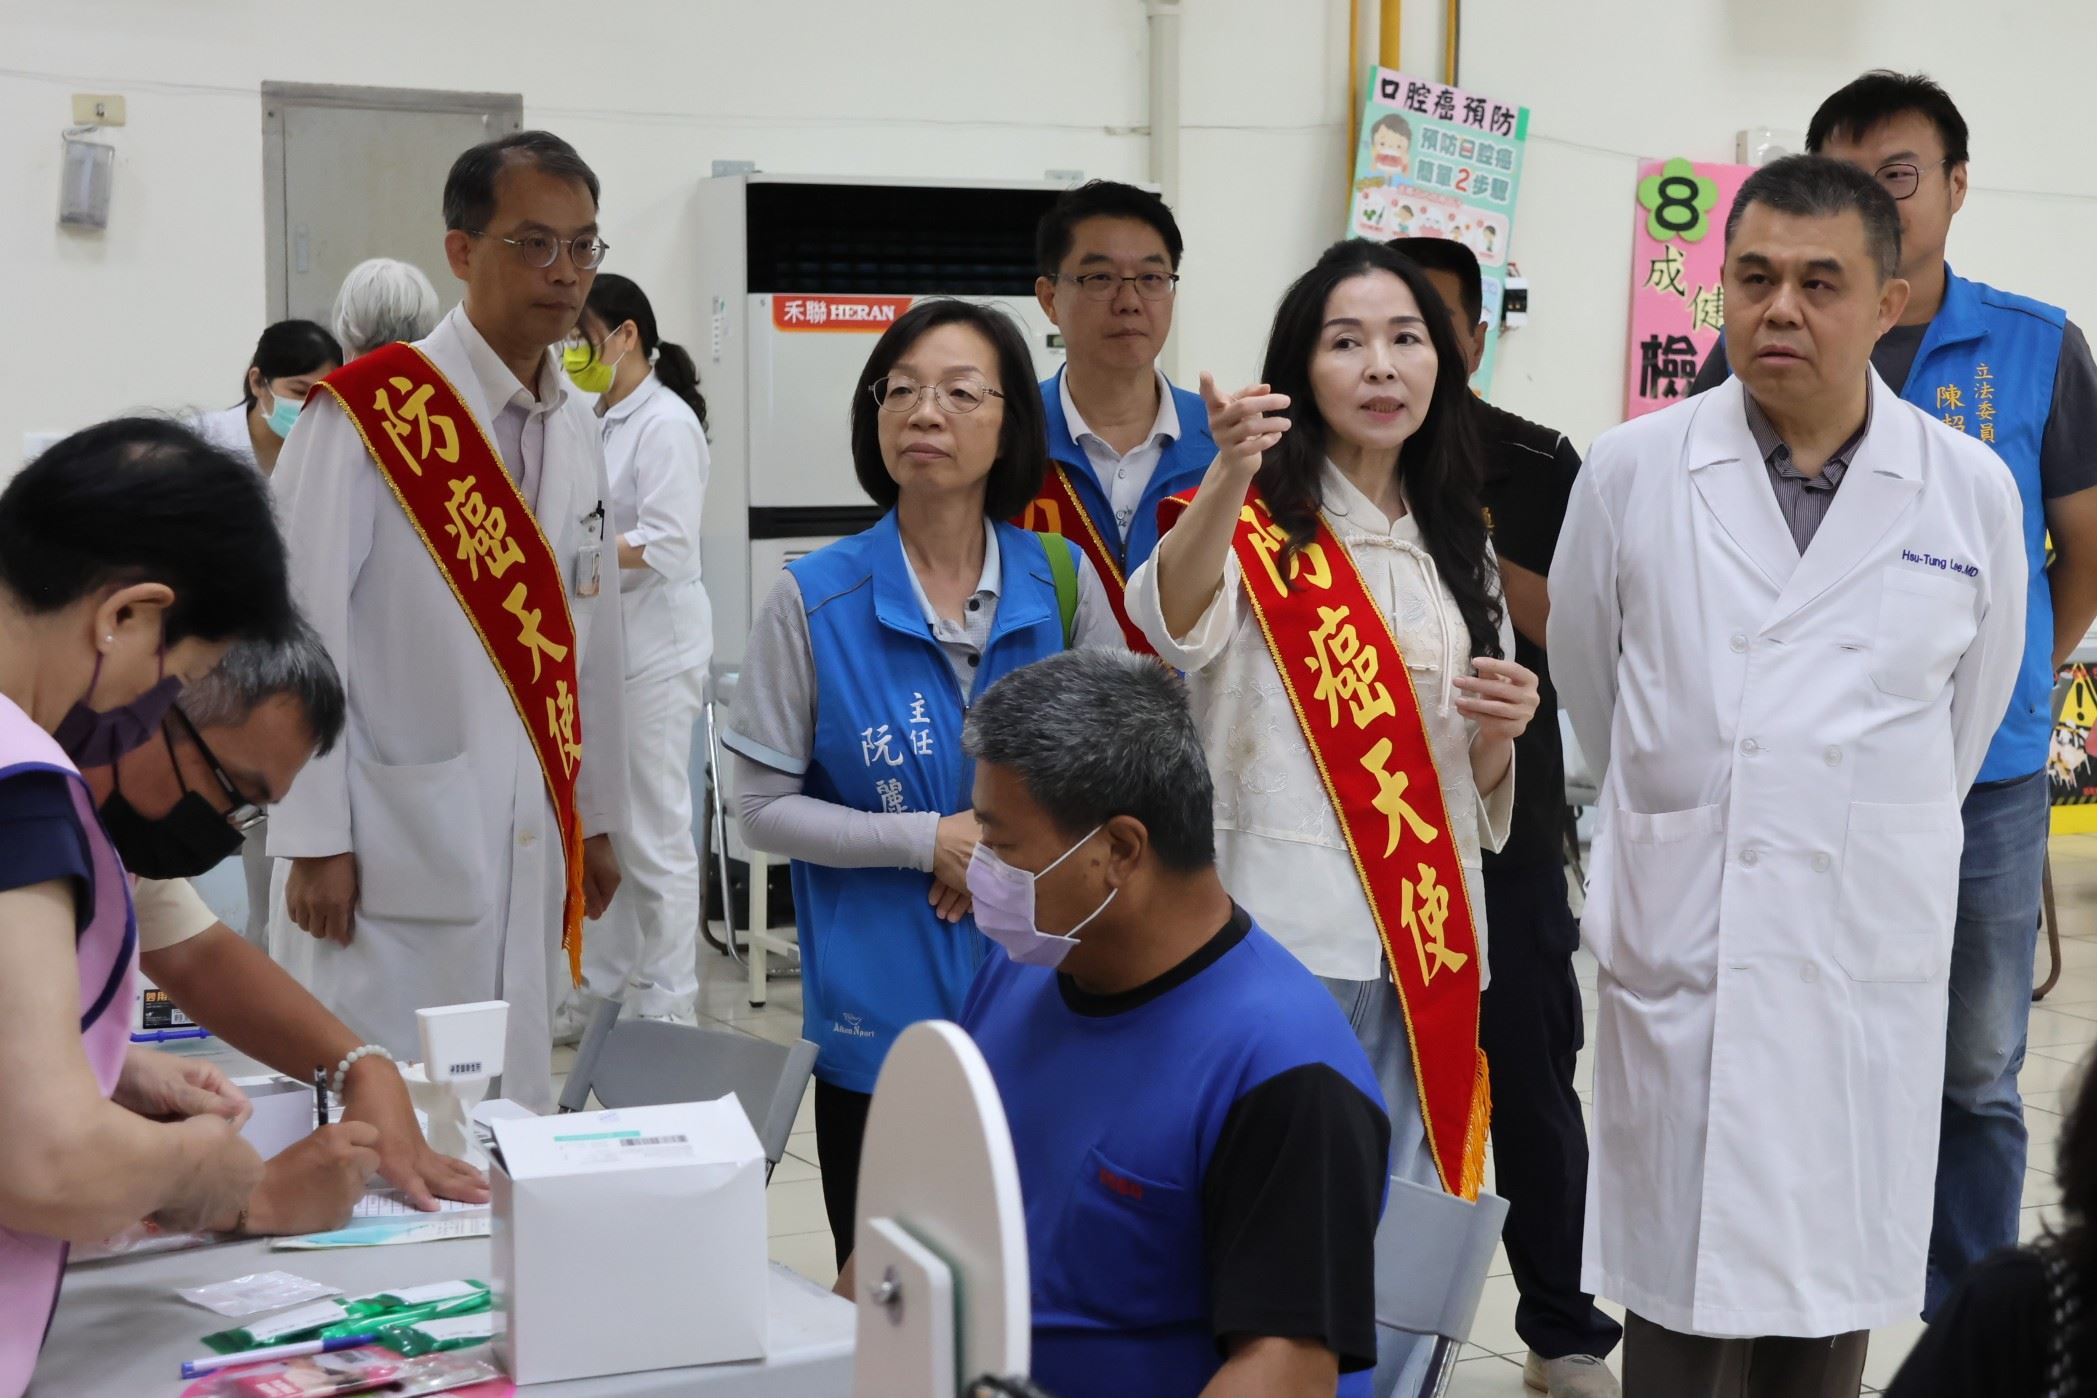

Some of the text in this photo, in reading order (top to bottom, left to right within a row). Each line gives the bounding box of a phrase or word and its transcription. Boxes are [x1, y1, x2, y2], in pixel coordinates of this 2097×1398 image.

[1381, 78, 1515, 137] 口腔癌預防
[1420, 126, 1514, 171] 預防口腔癌
[1655, 176, 1699, 231] 8
[784, 300, 896, 324] 禾聯 HERAN
[1973, 362, 1998, 443] 立法委員
[373, 375, 582, 780] 防癌天使
[1902, 549, 1947, 570] Hsu-Tung
[909, 692, 934, 756] 主任
[1238, 498, 1469, 988] 防癌天使
